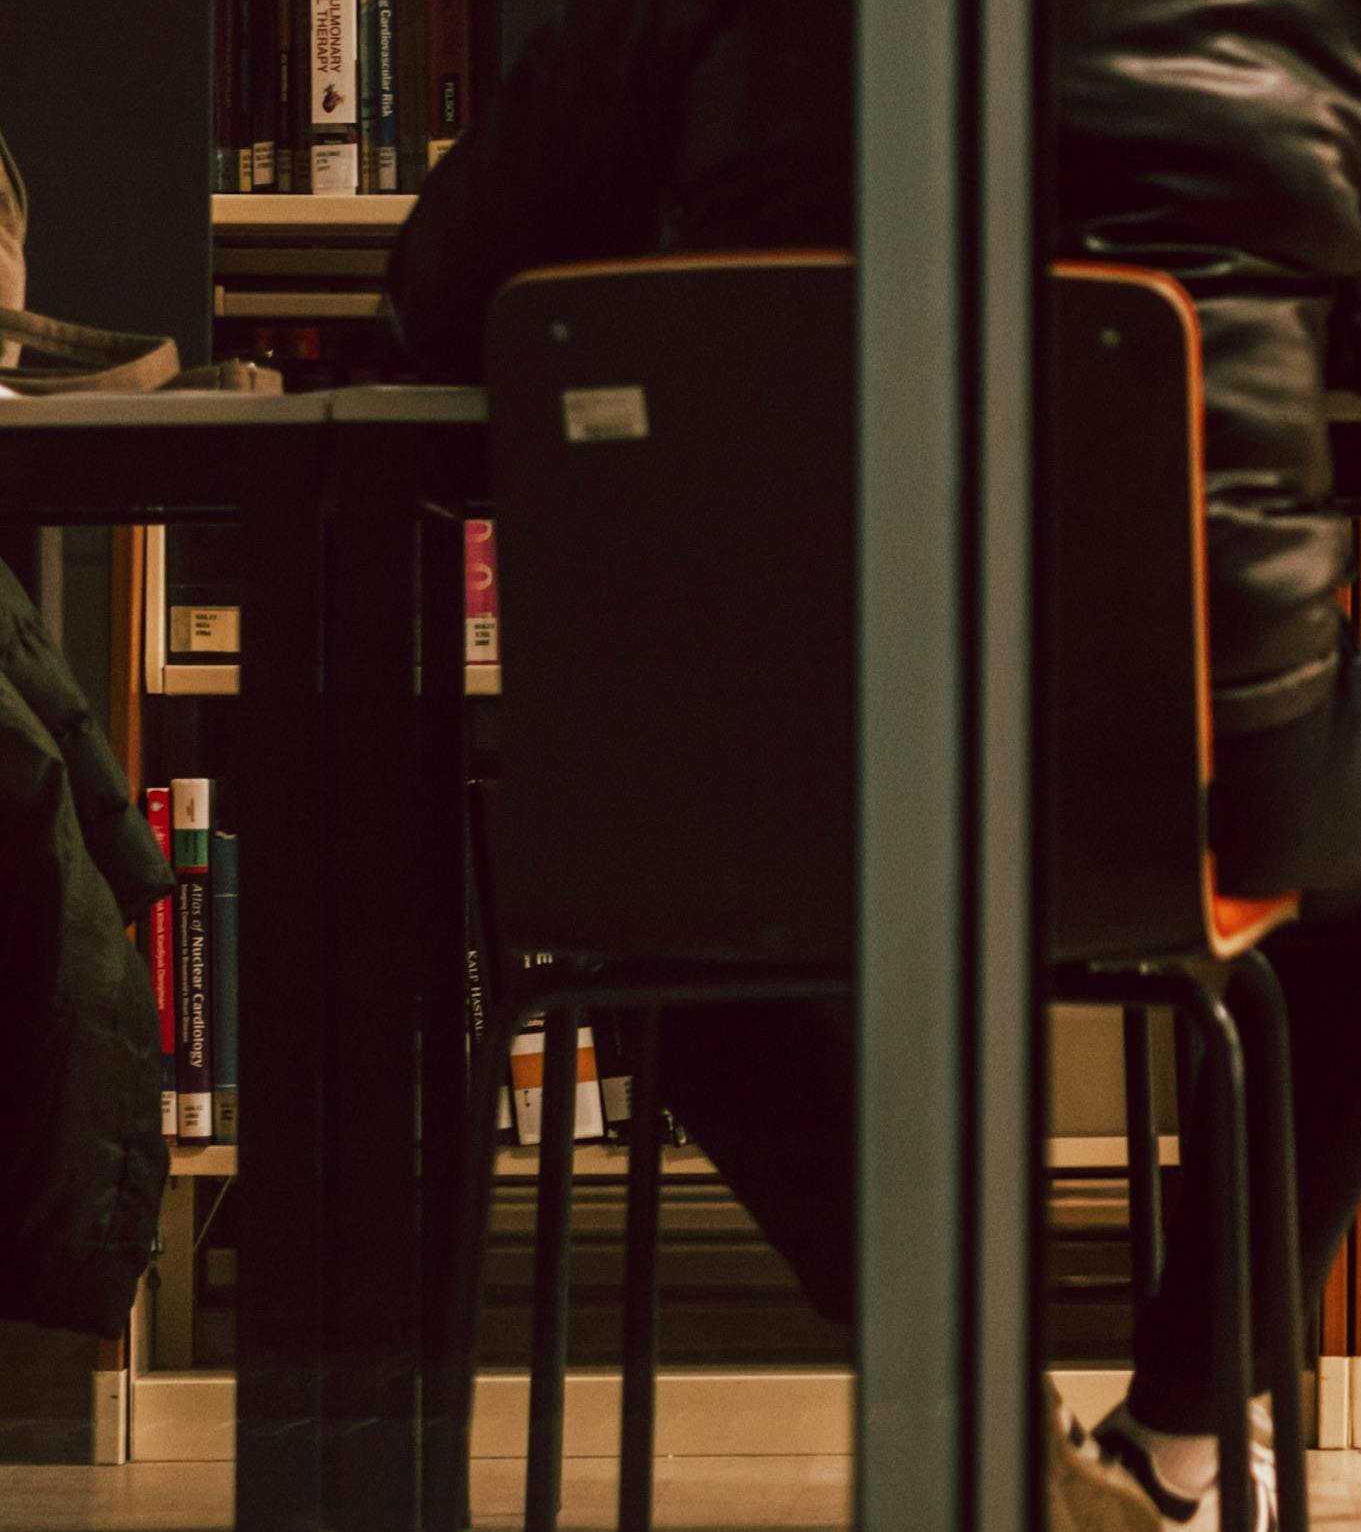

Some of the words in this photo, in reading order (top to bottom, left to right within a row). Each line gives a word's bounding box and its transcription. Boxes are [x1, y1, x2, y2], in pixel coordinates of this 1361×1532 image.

[316, 10, 329, 74] THERAPY
[381, 9, 392, 91] Cardiovascular
[382, 93, 393, 117] Risk
[190, 883, 204, 918] Atlas
[190, 919, 204, 932] of
[192, 935, 206, 989] Nuclear
[190, 993, 205, 1068] Cardiology
